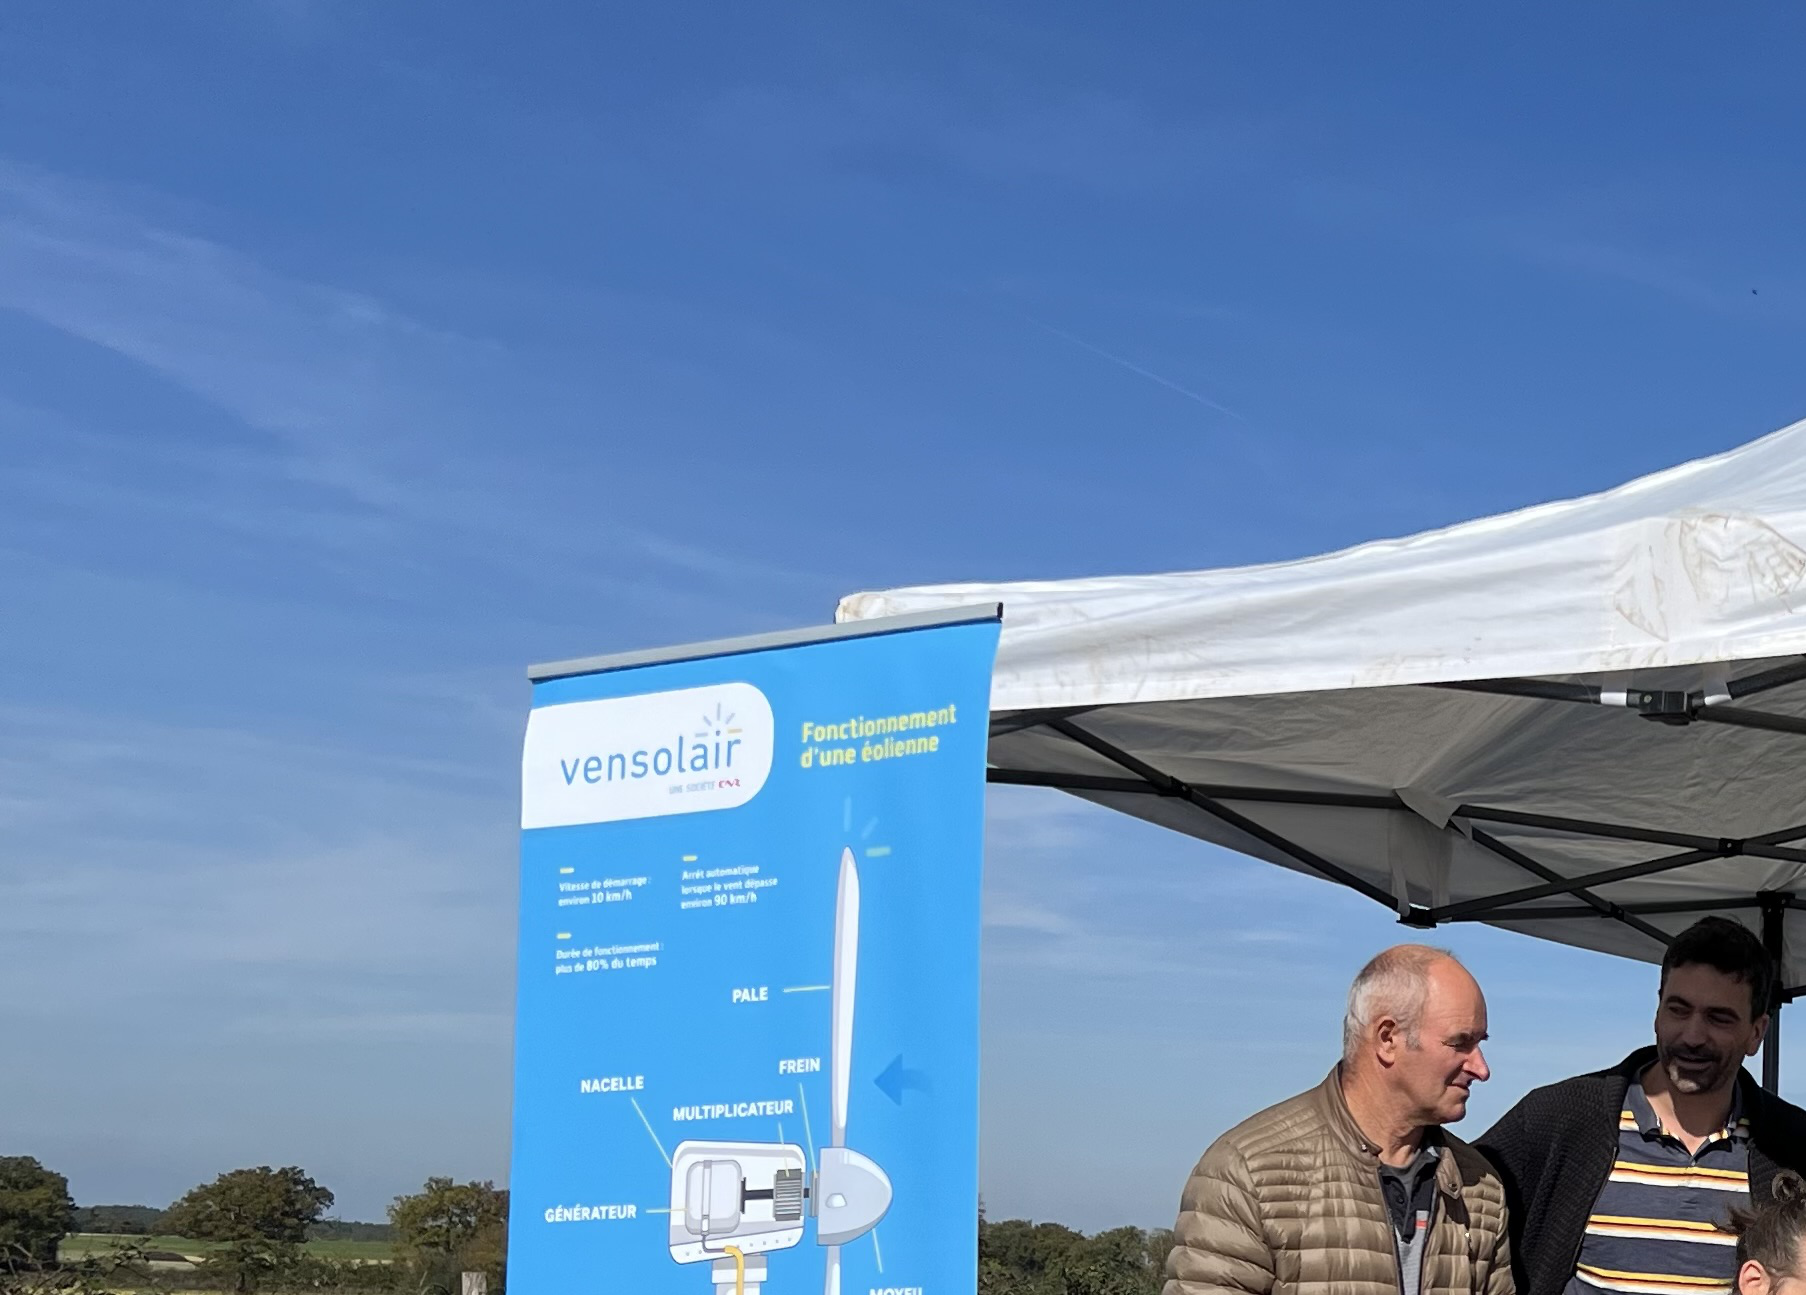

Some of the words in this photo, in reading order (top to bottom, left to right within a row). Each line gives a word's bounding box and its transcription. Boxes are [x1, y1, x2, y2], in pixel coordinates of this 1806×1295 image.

[801, 704, 957, 743] Fonctionnement
[561, 730, 741, 785] vensolair
[801, 746, 856, 768] d'une
[861, 735, 939, 762] éolienne
[706, 864, 760, 879] automatique
[559, 881, 590, 892] Vitesse
[591, 880, 601, 889] de
[603, 876, 648, 888] démarrage
[681, 884, 712, 896] lorsque
[713, 881, 722, 891] le
[723, 880, 743, 891] vent
[744, 877, 778, 890] dépasse
[558, 896, 590, 906] environ
[591, 892, 604, 904] 10
[606, 889, 632, 902] km/h
[680, 898, 713, 909] environ
[714, 894, 728, 906] 90
[730, 892, 757, 904] km/h
[556, 949, 581, 960] Durée
[582, 948, 593, 957] de
[594, 942, 660, 957] fonctionnement
[574, 963, 585, 972] de
[586, 959, 609, 971] 80%
[611, 958, 624, 969] du
[625, 955, 657, 969] temps
[732, 986, 768, 1003] PALE
[779, 1057, 820, 1075] FREIN
[580, 1075, 645, 1094] NACELLE
[673, 1099, 793, 1121] MULTIPLICATEUR
[544, 1203, 637, 1223] GÉNÉRATEUR
